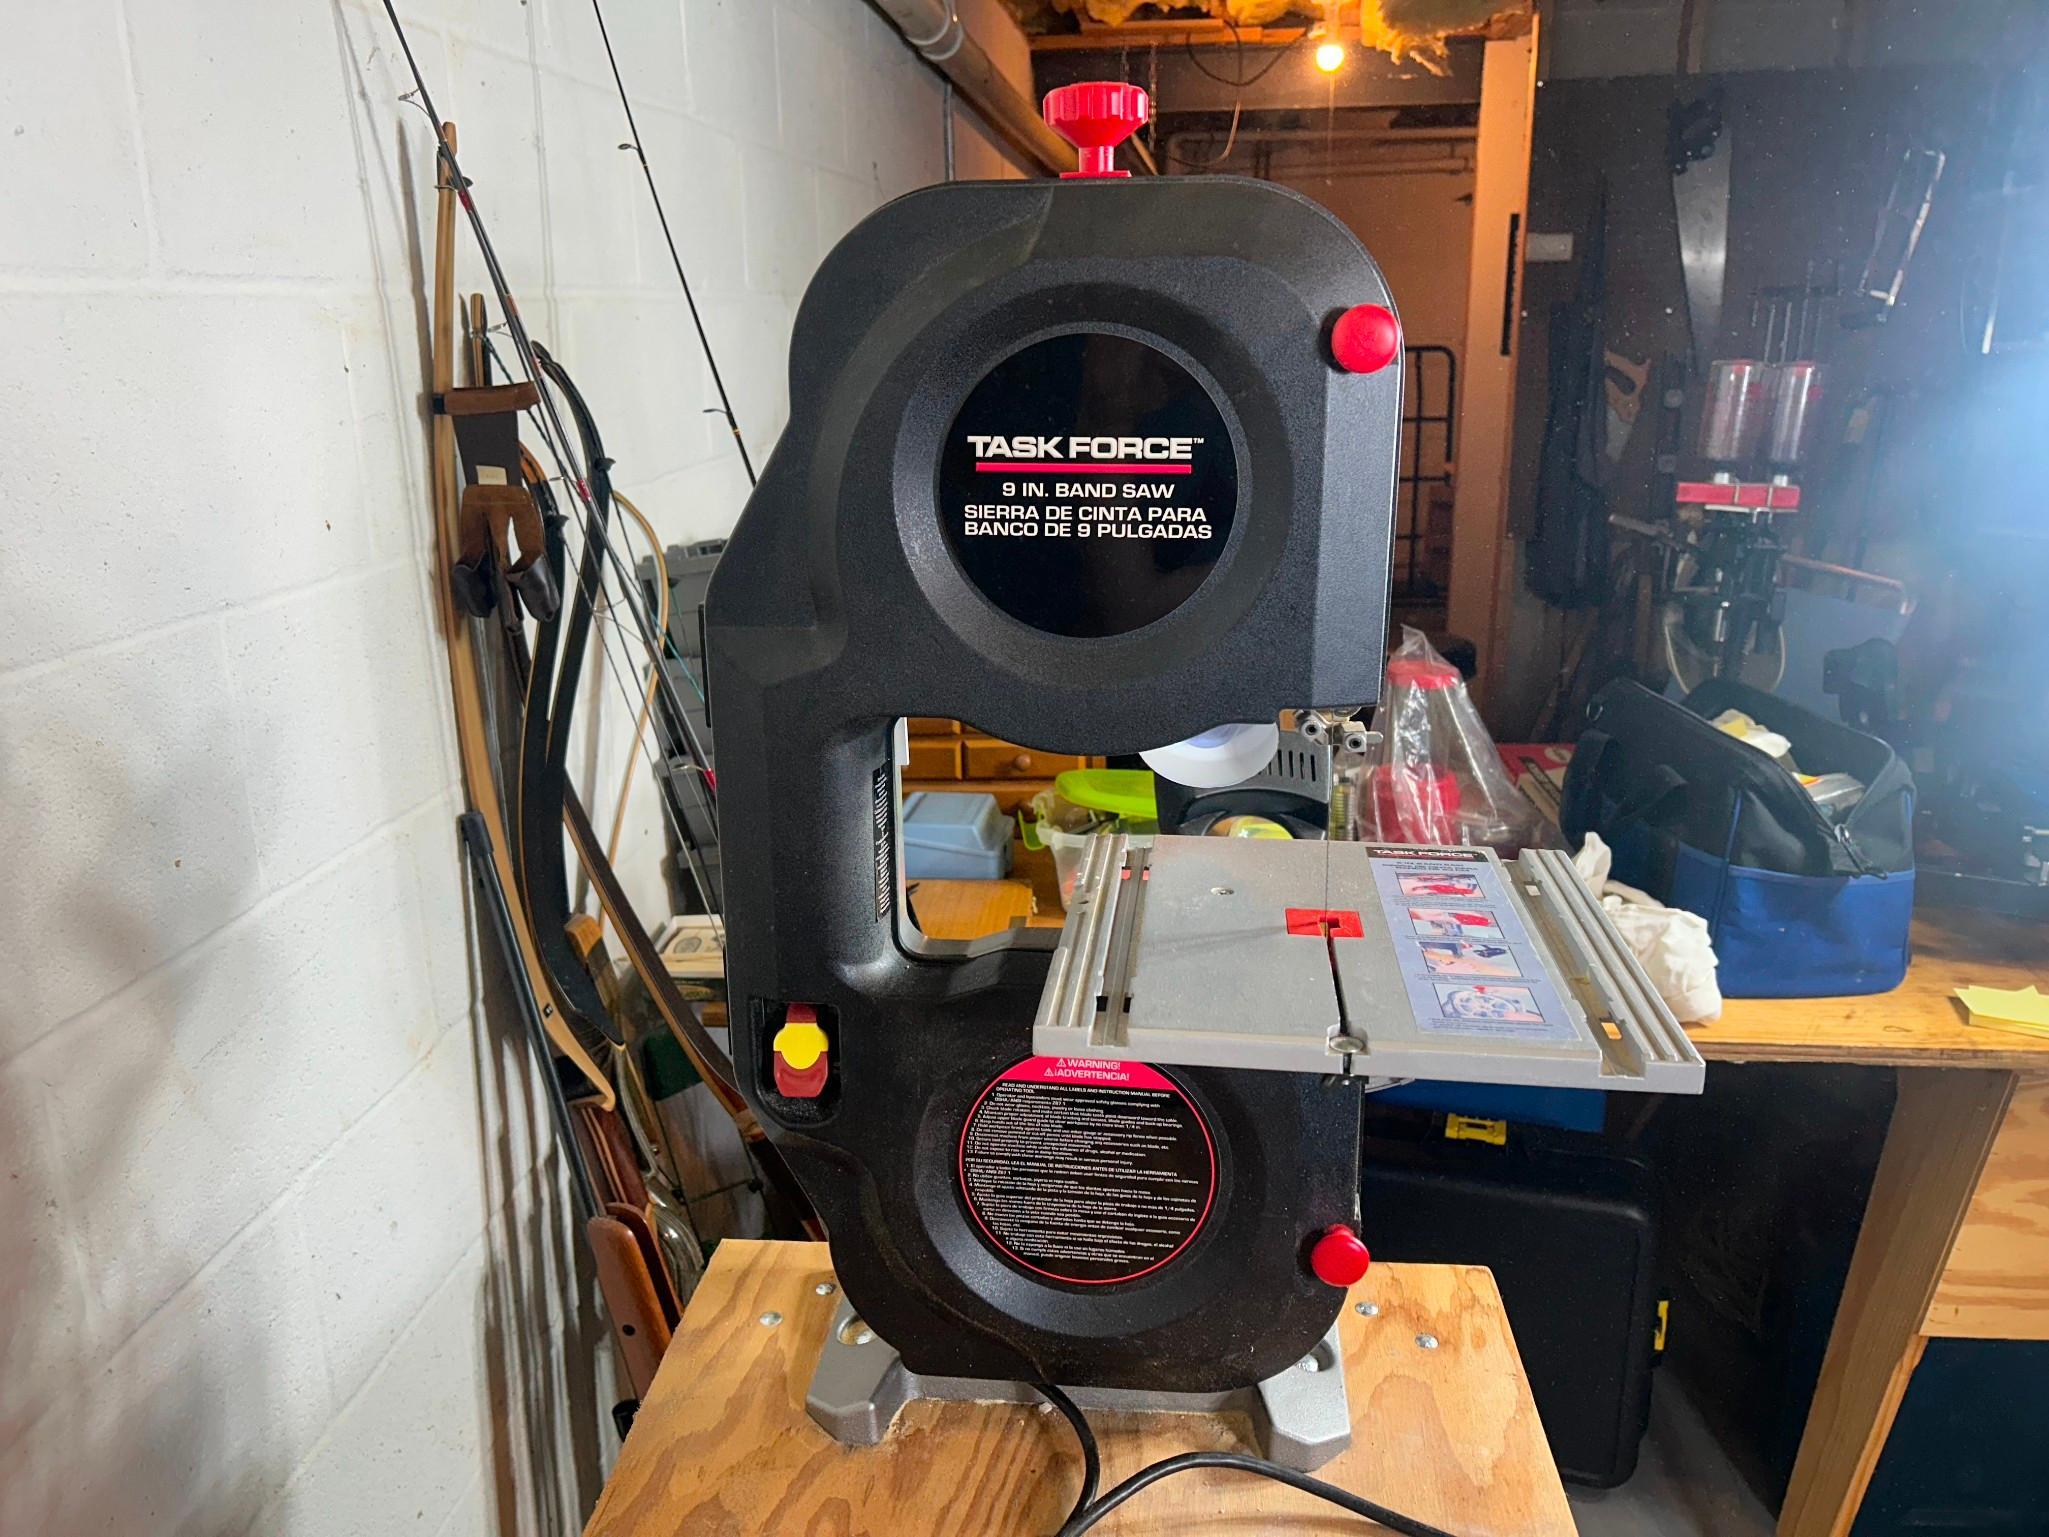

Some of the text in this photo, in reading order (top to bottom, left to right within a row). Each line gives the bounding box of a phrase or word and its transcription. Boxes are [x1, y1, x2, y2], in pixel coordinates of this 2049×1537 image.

[967, 436, 1064, 459] TASK
[1002, 482, 1175, 499] 9 IN. BAND SAW
[964, 505, 1207, 522] SIERRA DE CINTA PARA
[964, 522, 1213, 539] BANCO DE 9 PULGADAS
[1067, 1059, 1120, 1070] WARNING!
